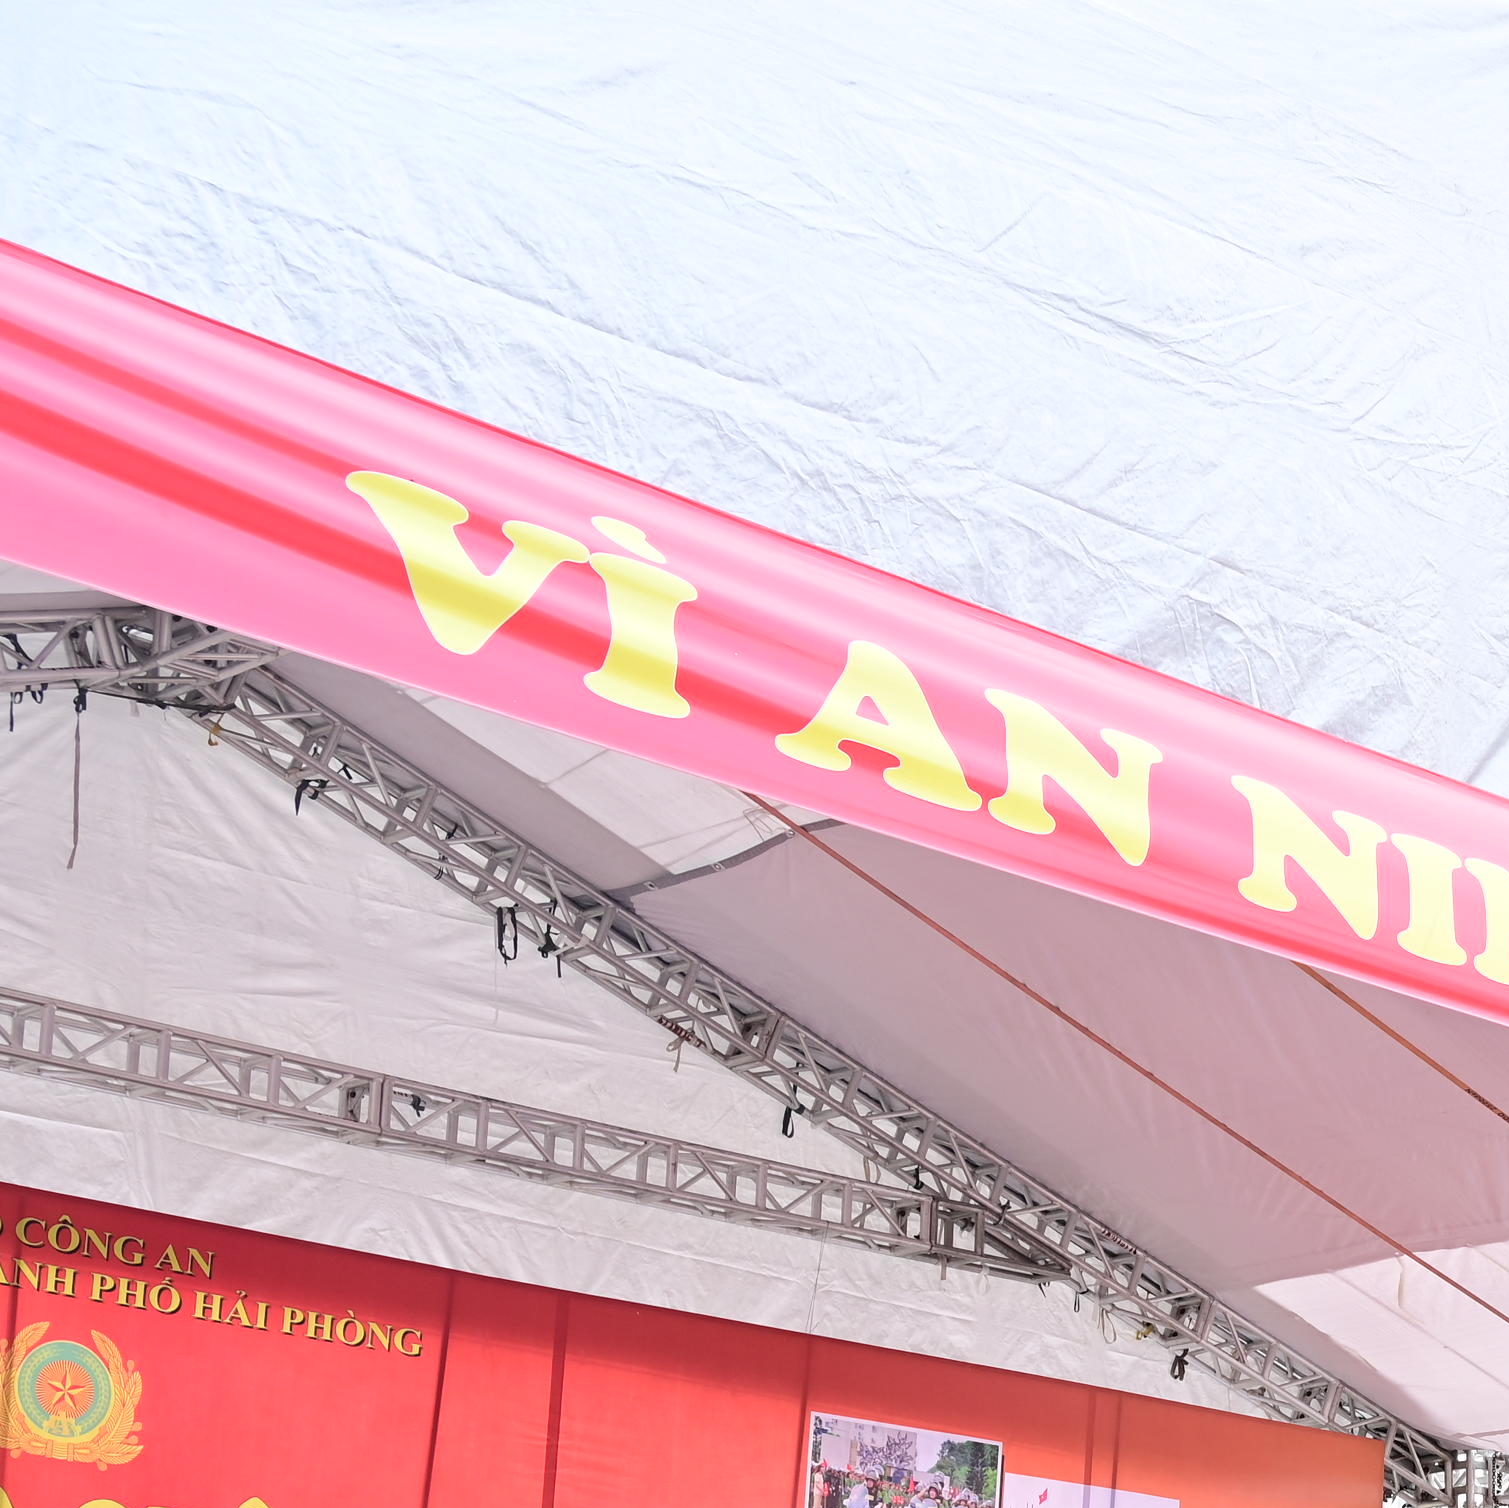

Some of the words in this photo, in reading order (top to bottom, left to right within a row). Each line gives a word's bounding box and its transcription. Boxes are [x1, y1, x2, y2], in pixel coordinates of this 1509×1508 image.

[346, 471, 698, 718] VÌ
[775, 640, 1163, 866] AN
[16, 1214, 146, 1266] CÔNG
[154, 1243, 215, 1279] AN
[89, 1276, 182, 1314] PHỐ
[192, 1289, 270, 1331] HẢI
[280, 1306, 423, 1356] PHÒNG
